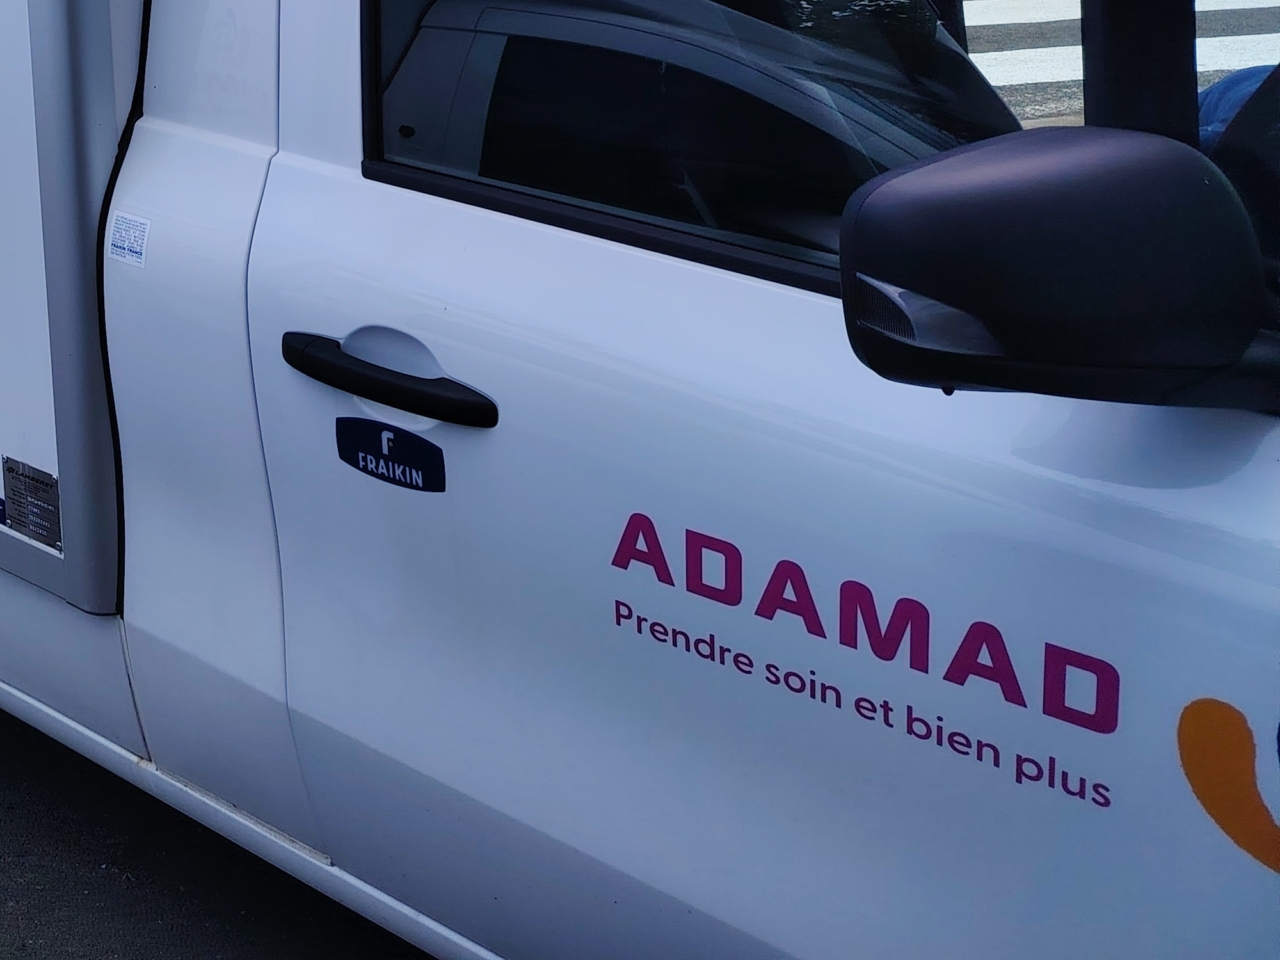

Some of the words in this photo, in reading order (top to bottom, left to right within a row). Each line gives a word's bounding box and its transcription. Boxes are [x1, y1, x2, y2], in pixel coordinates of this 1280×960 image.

[15, 470, 55, 490] LAMBERET
[359, 453, 422, 487] FRAIKIN
[611, 513, 1120, 734] ADAMAD
[615, 600, 753, 674] Prendre
[766, 664, 841, 708] soin
[855, 698, 893, 728] et
[907, 705, 1000, 768] bien
[1016, 754, 1111, 807] plus
